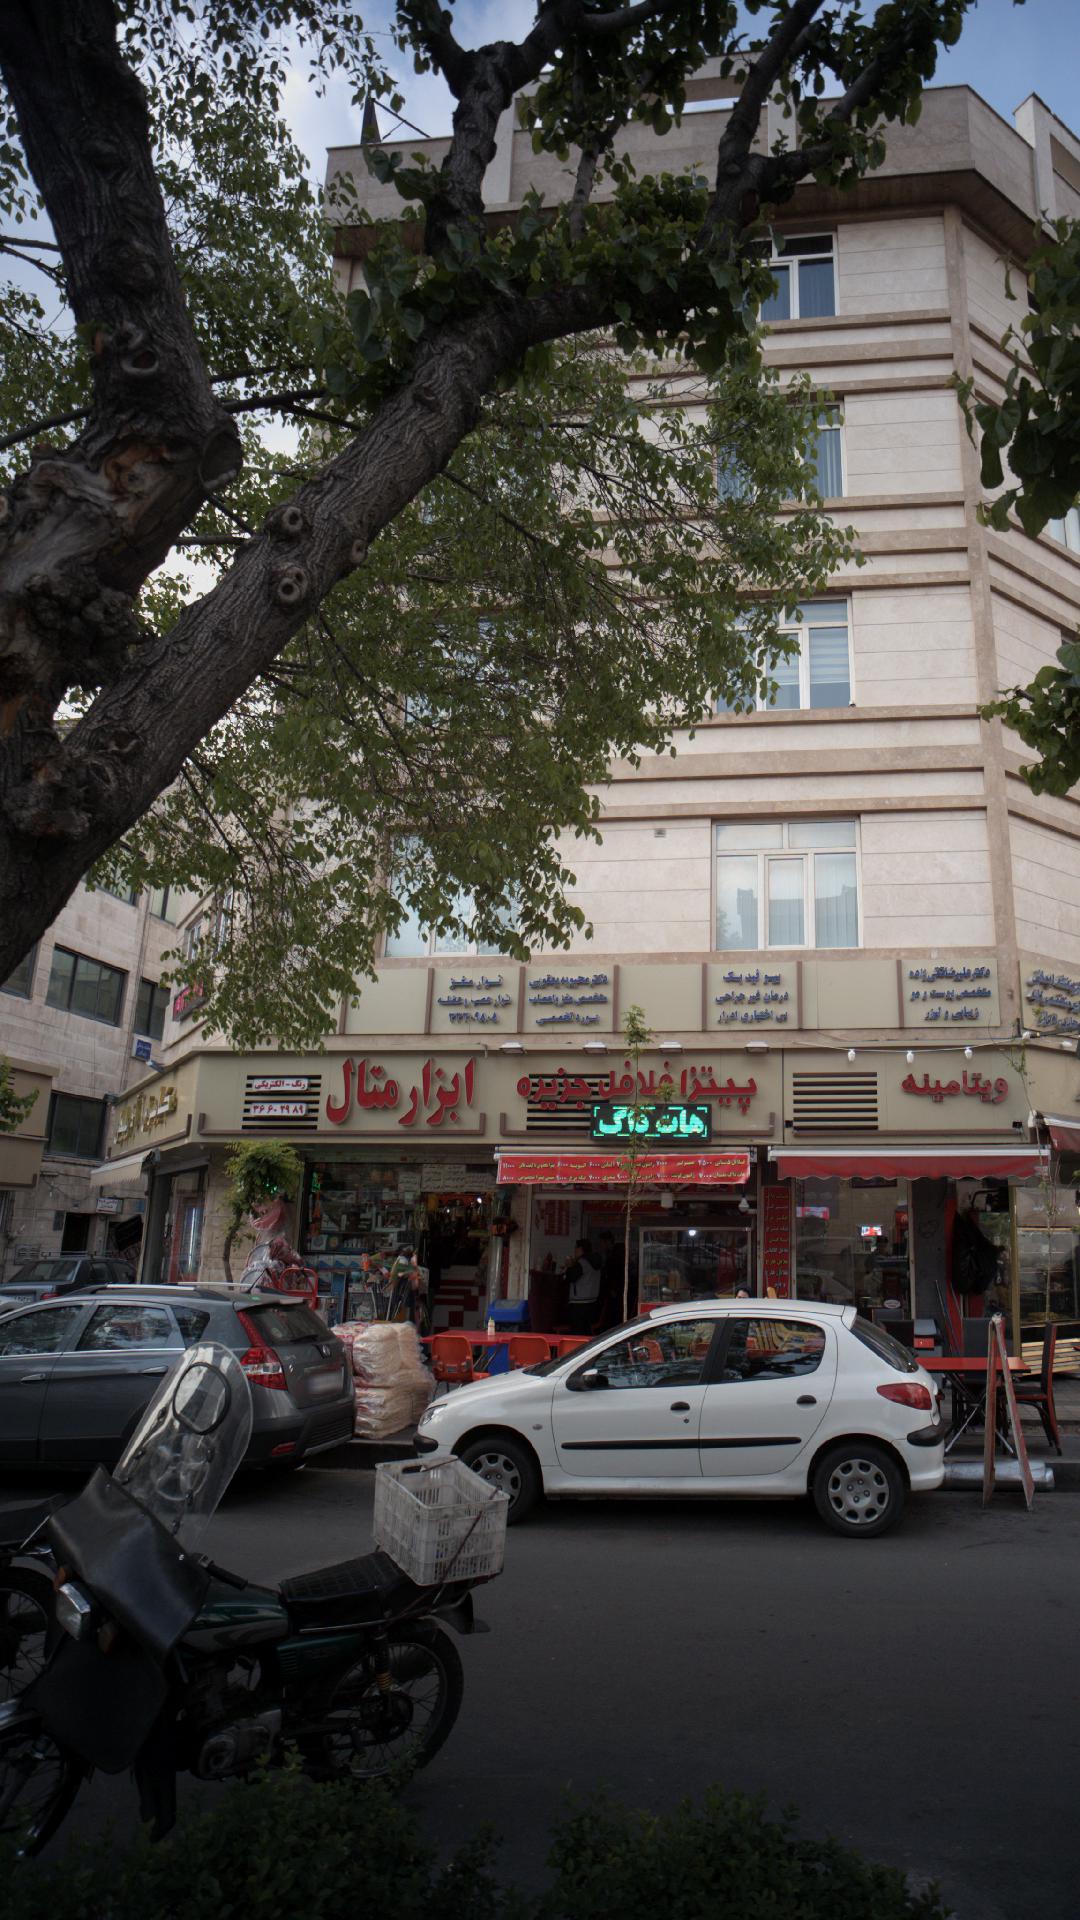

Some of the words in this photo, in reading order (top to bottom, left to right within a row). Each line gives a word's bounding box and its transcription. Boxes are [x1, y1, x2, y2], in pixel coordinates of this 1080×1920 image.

[592, 973, 608, 987] دکتر
[970, 966, 991, 981] دکتر
[449, 975, 474, 990] مغز
[476, 974, 503, 990] نوار
[575, 992, 608, 1006] متخصص
[715, 991, 745, 1005] جراحی
[747, 989, 761, 1004] غیر
[763, 990, 789, 1004] درمان
[910, 990, 920, 1001] مو
[922, 991, 927, 1001] و
[930, 988, 955, 1001] پوست
[956, 986, 992, 999] متخصص
[494, 993, 512, 1008] نوار
[717, 1010, 738, 1024] ادرار
[741, 1009, 774, 1024] اختیاری
[776, 1011, 788, 1023] بی
[952, 1006, 979, 1020] زیبایی
[254, 1079, 285, 1090] الکتریکی
[292, 1079, 306, 1090] رنگ
[598, 1060, 677, 1098] فلافل
[901, 1069, 1009, 1104] ویتامینه
[326, 1056, 399, 1126] متال
[398, 1056, 476, 1126] ابزار
[517, 1067, 592, 1109] جزیره
[680, 1065, 757, 1115] پیتزا
[599, 1108, 650, 1135] داگ
[656, 1108, 706, 1134] هات
